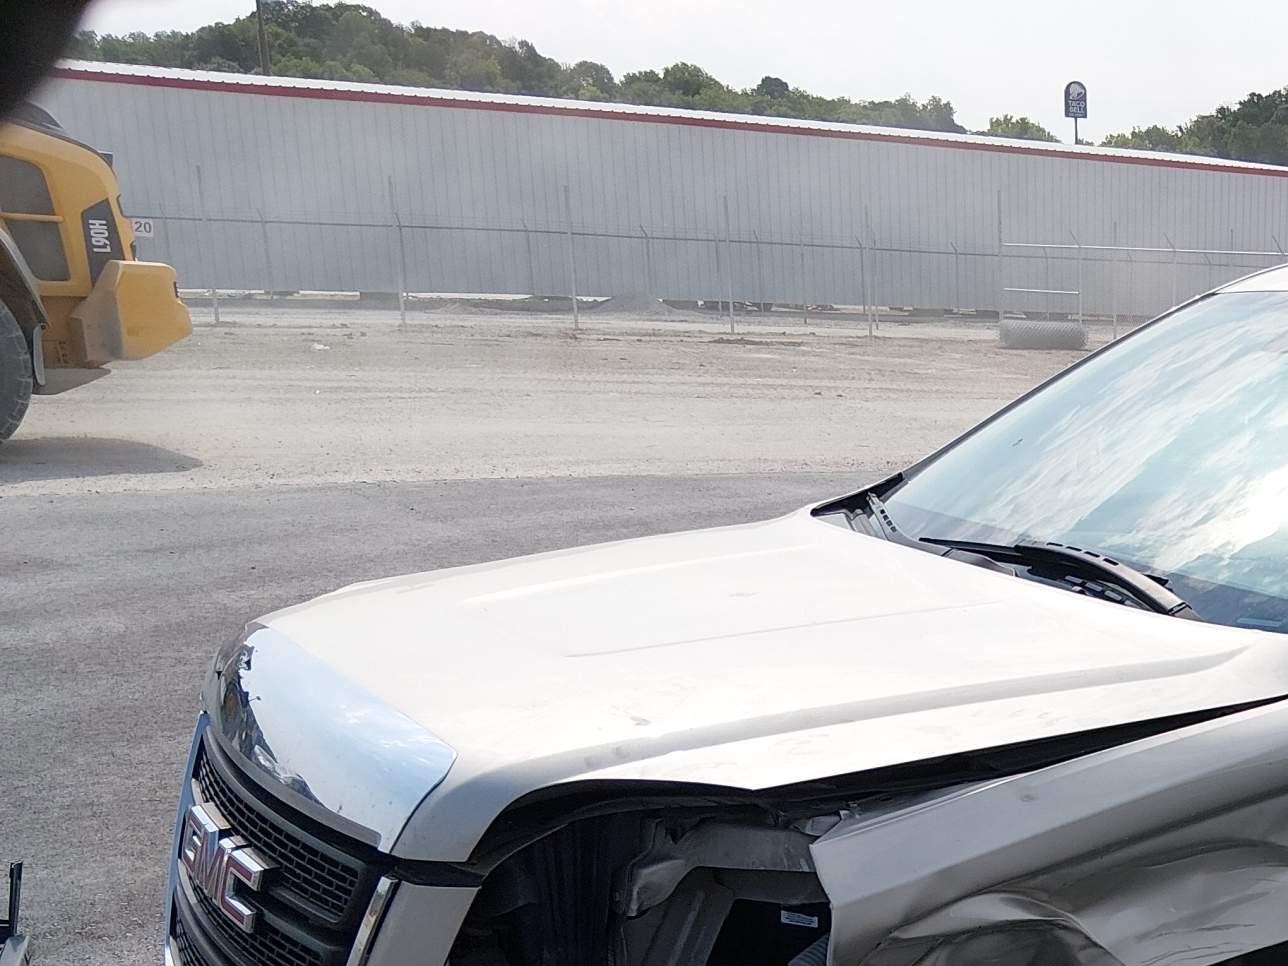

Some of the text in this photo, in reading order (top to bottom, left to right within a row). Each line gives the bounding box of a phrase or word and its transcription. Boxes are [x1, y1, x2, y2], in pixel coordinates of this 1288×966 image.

[88, 219, 112, 253] L90H
[134, 221, 152, 233] 20
[182, 803, 264, 933] GMC
